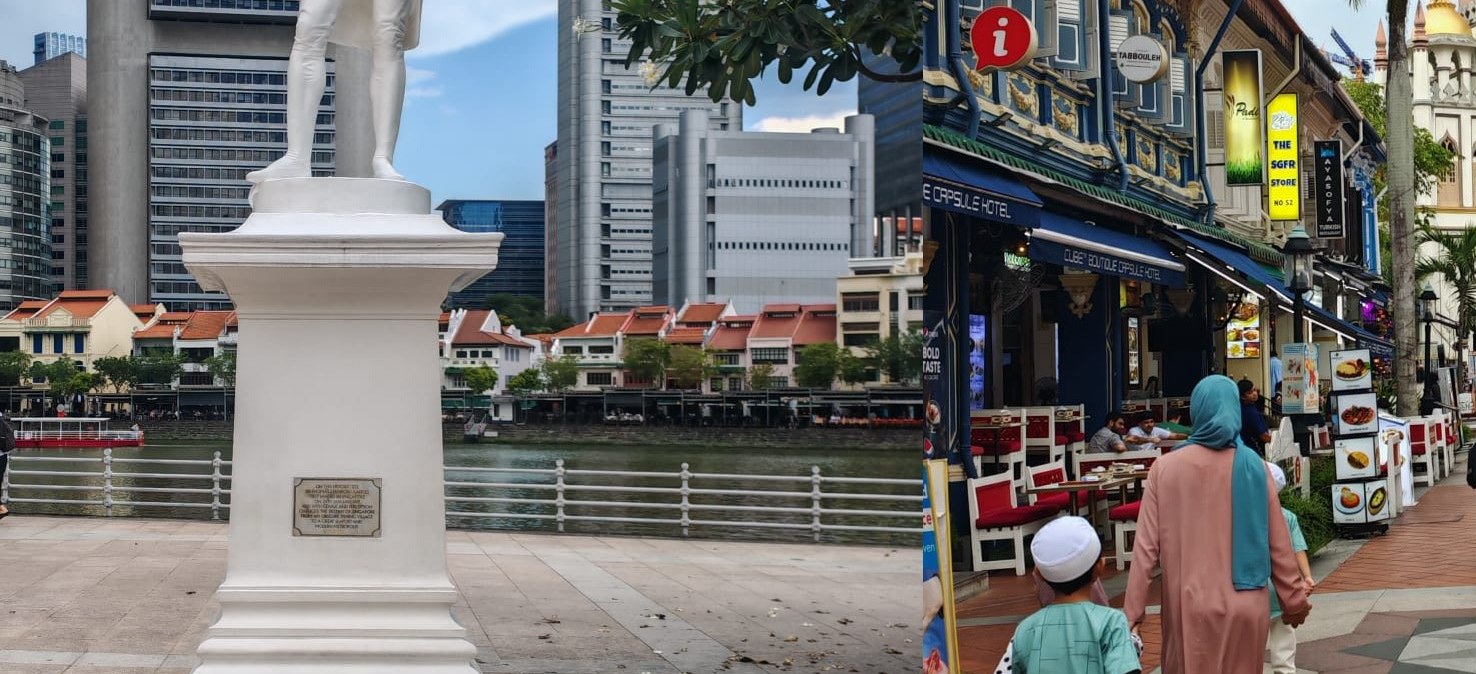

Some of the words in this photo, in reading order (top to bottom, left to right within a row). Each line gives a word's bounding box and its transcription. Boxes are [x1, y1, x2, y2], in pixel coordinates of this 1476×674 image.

[1119, 52, 1161, 62] TABBOULEH
[1273, 140, 1291, 150] THE
[1271, 160, 1296, 169] SGFR
[1271, 179, 1297, 187] STORE
[933, 186, 980, 211] CAPSULE
[981, 198, 1012, 219] HOTEL
[1088, 254, 1117, 272] BOUTIQUE
[1118, 261, 1145, 277] CAPSULE
[1145, 268, 1161, 280] HOTEL
[923, 347, 940, 359] BOLD
